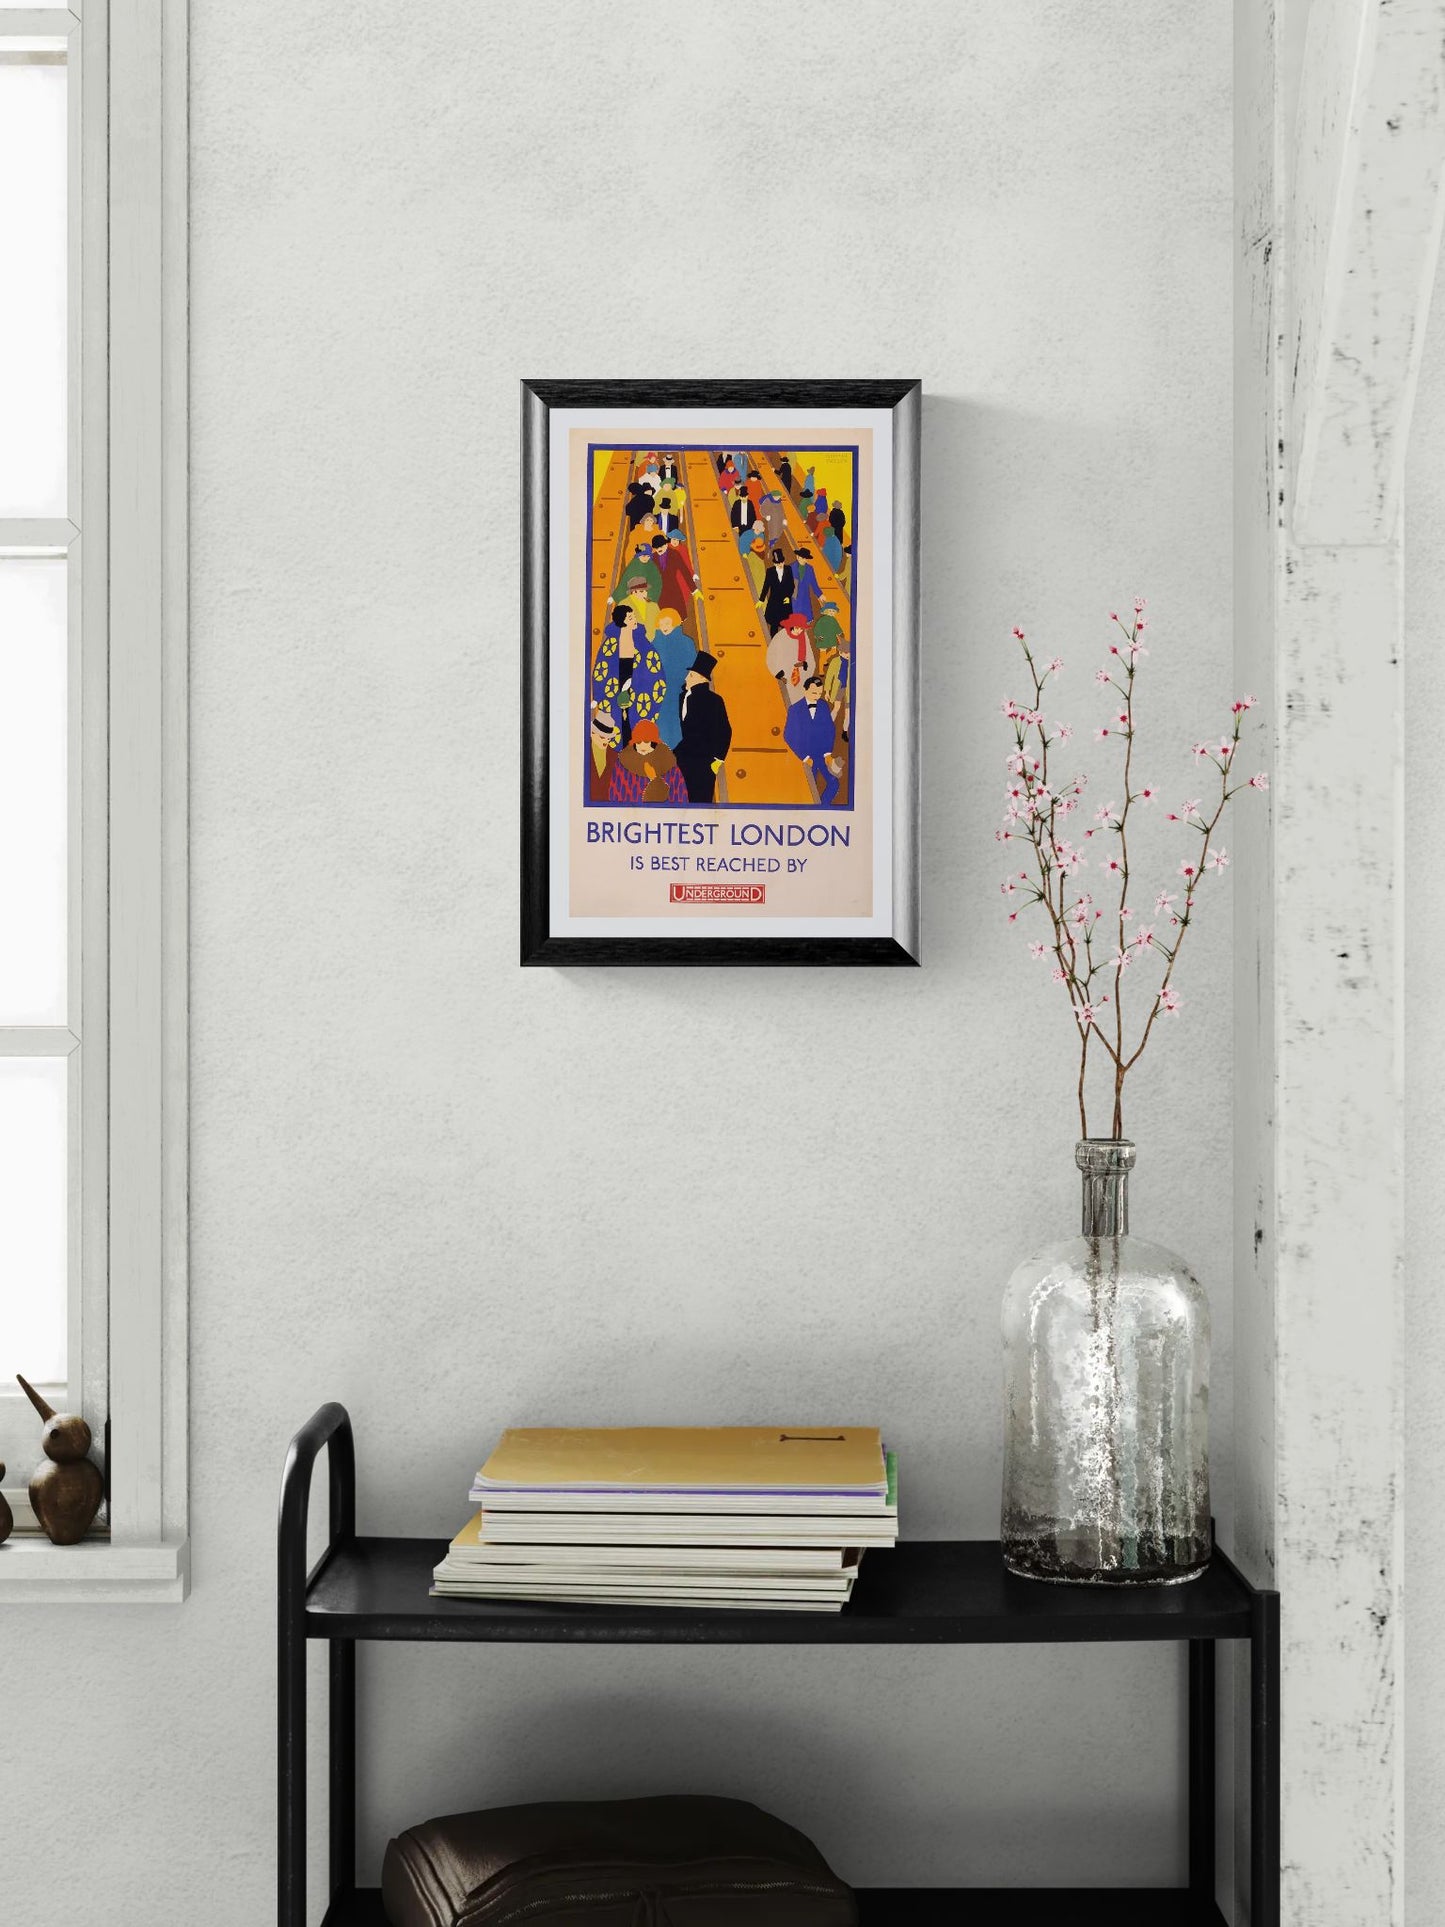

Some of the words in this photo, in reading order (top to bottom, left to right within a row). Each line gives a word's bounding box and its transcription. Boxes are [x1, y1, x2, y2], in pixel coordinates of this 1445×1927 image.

[586, 821, 719, 845] BRIGHTEST
[730, 823, 851, 847] LONDON
[630, 855, 644, 870] IS
[650, 855, 690, 872] BEST
[696, 857, 781, 873] REACHED
[787, 858, 808, 873] BY
[673, 885, 762, 902] UNDERGROUND
